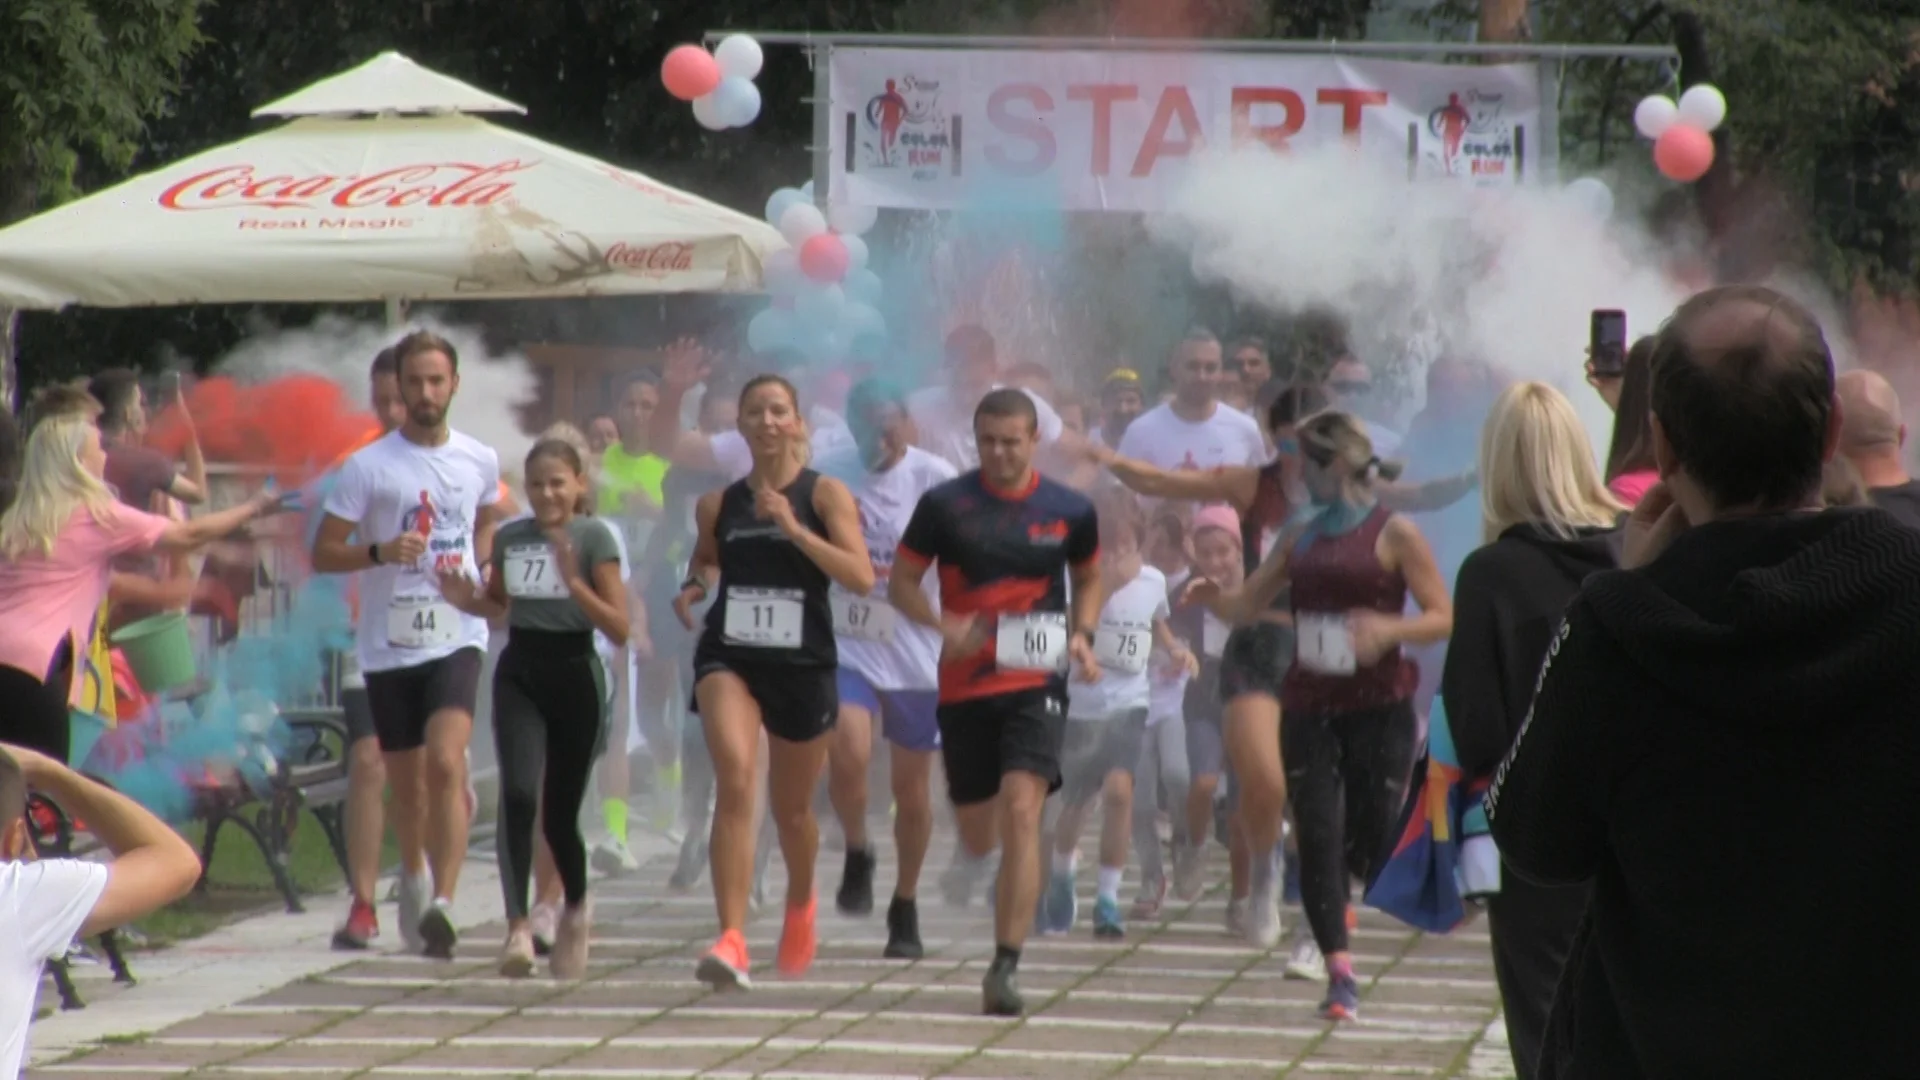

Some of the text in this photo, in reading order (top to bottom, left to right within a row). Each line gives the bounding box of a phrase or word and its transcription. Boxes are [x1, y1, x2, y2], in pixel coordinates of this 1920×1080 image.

[983, 82, 1388, 178] START
[908, 149, 942, 167] RUN
[1471, 159, 1505, 176] RUN
[238, 217, 413, 231] Real Magic
[523, 559, 546, 582] 77
[411, 609, 436, 631] 44
[752, 604, 774, 630] 11
[848, 605, 871, 626] 67
[1116, 633, 1138, 656] 75
